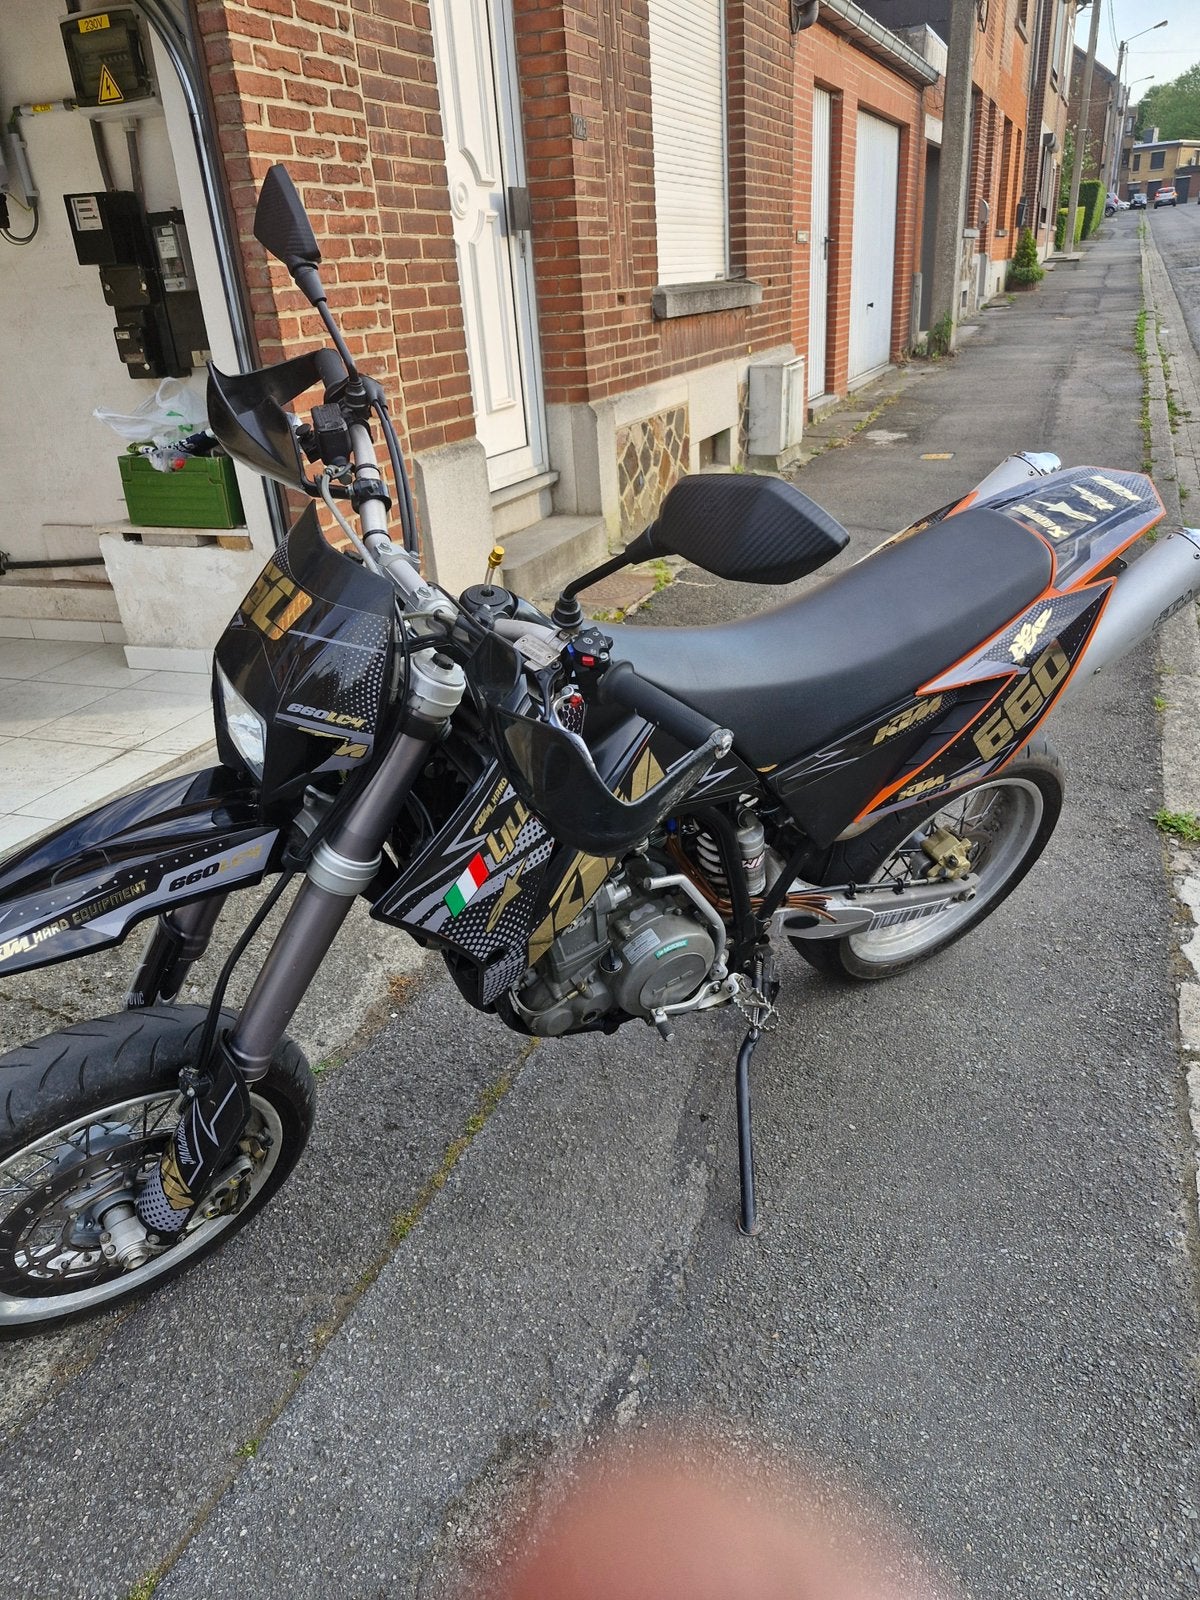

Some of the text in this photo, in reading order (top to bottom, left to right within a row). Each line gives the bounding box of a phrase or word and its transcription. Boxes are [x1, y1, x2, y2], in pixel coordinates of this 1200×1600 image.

[85, 17, 103, 31] 230V
[872, 695, 944, 746] KTM
[973, 638, 1071, 762] 660
[491, 777, 509, 805] HARD
[32, 919, 70, 943] HARD
[72, 880, 147, 925] EQUIPMENT
